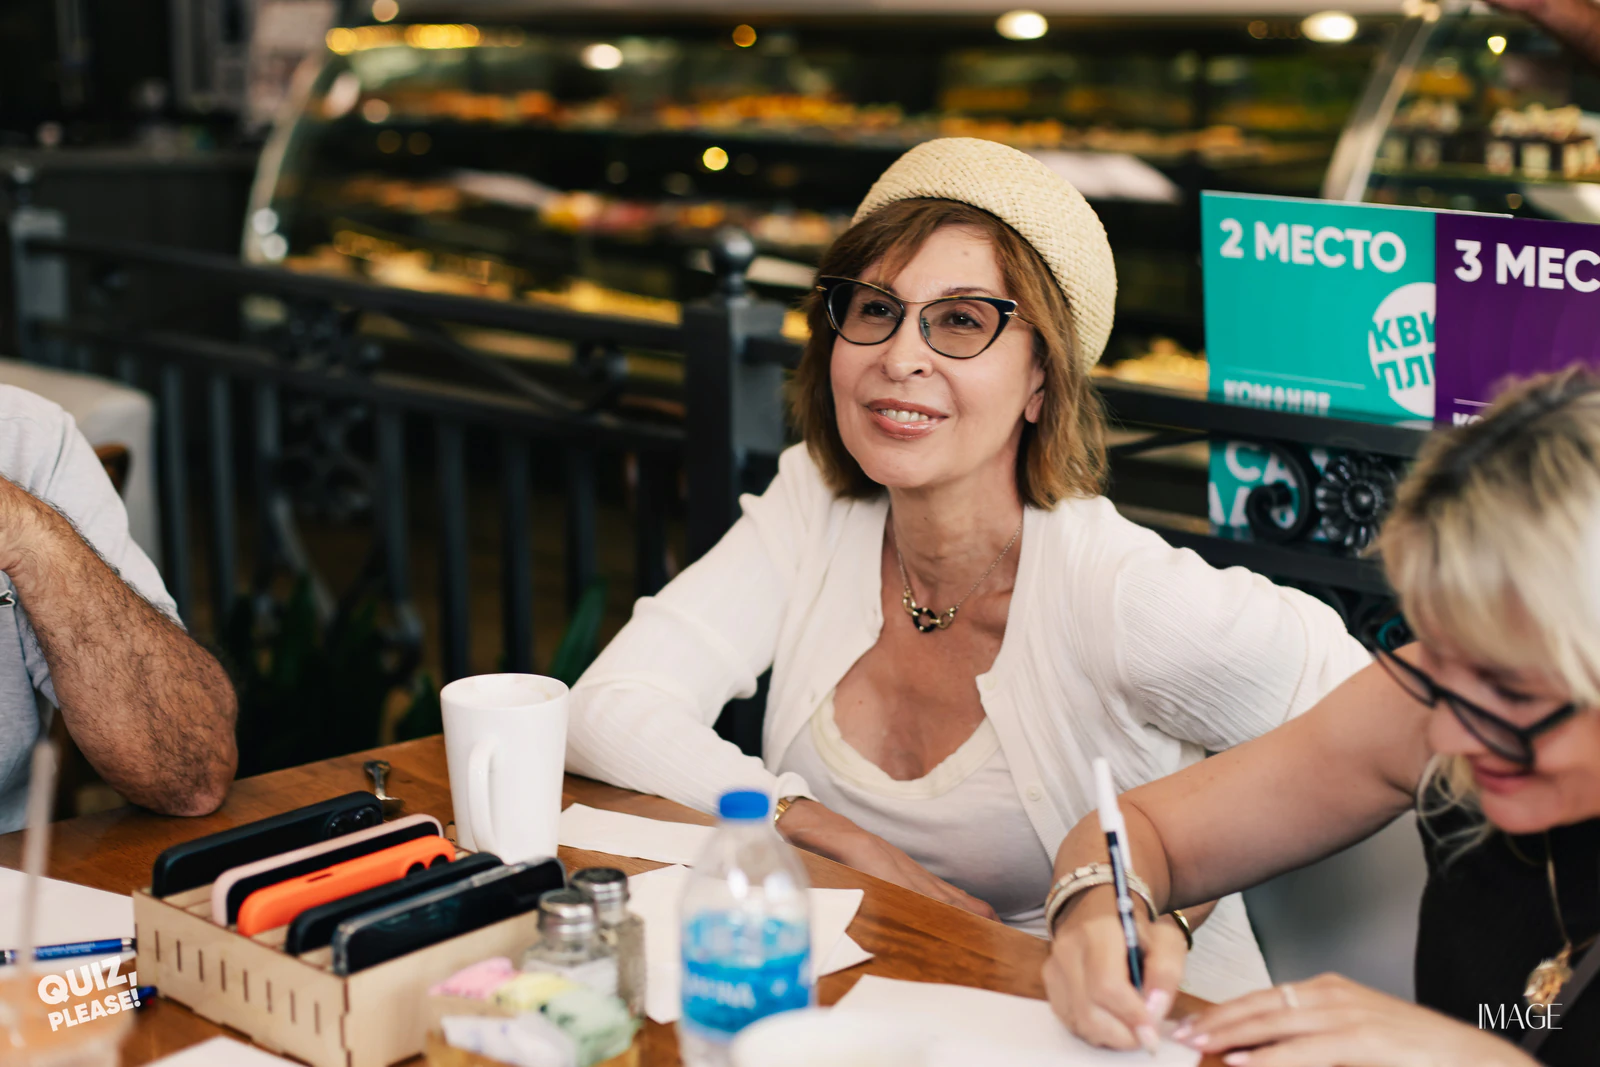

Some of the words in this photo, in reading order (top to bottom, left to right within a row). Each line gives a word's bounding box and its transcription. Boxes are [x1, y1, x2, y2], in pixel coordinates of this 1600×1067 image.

[1219, 218, 1244, 259] 2
[1254, 221, 1407, 273] МЕСТО
[1454, 239, 1483, 282] 3
[1496, 243, 1600, 293] МЕС
